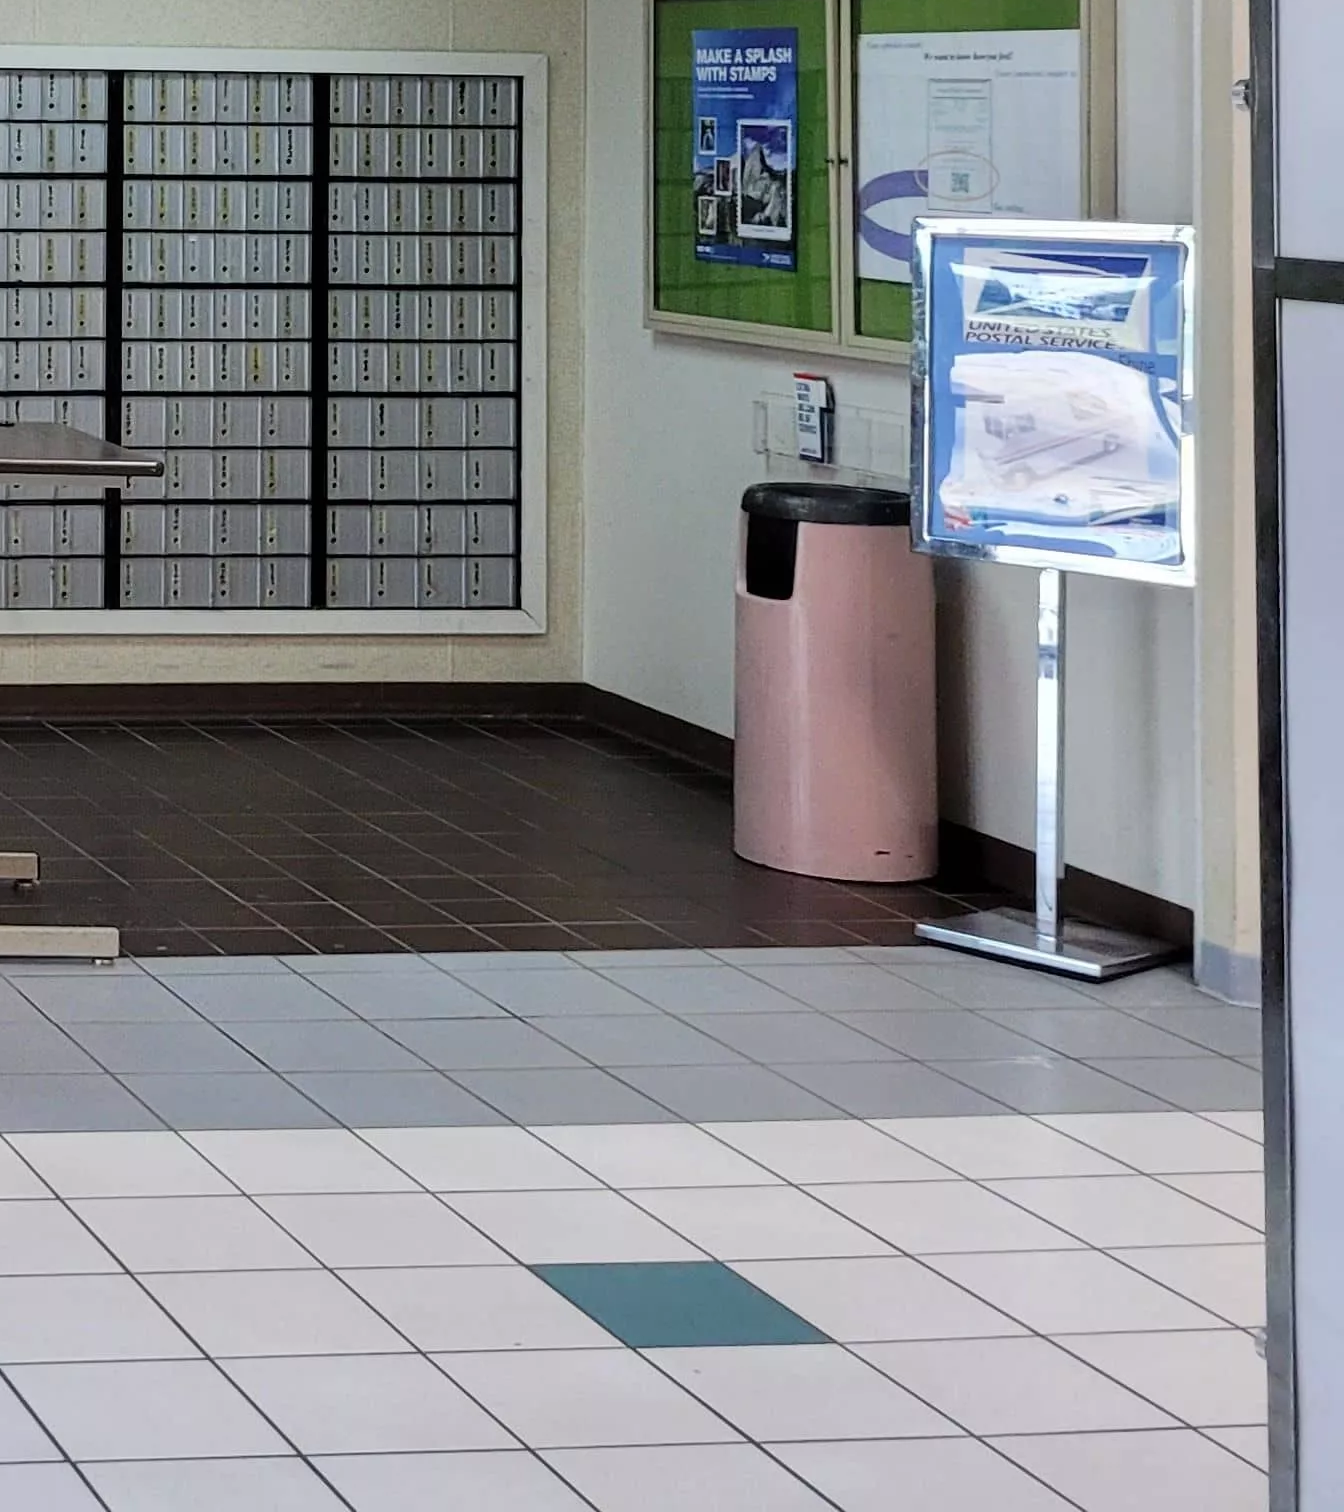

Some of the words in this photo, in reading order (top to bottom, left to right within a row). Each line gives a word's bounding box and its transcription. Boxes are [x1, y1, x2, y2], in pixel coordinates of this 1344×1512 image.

[697, 49, 732, 64] MAKE
[734, 49, 743, 64] A
[745, 48, 792, 64] SPLASH
[696, 66, 727, 82] WITH
[729, 66, 776, 82] STAMPS
[965, 331, 1034, 346] POSTAL
